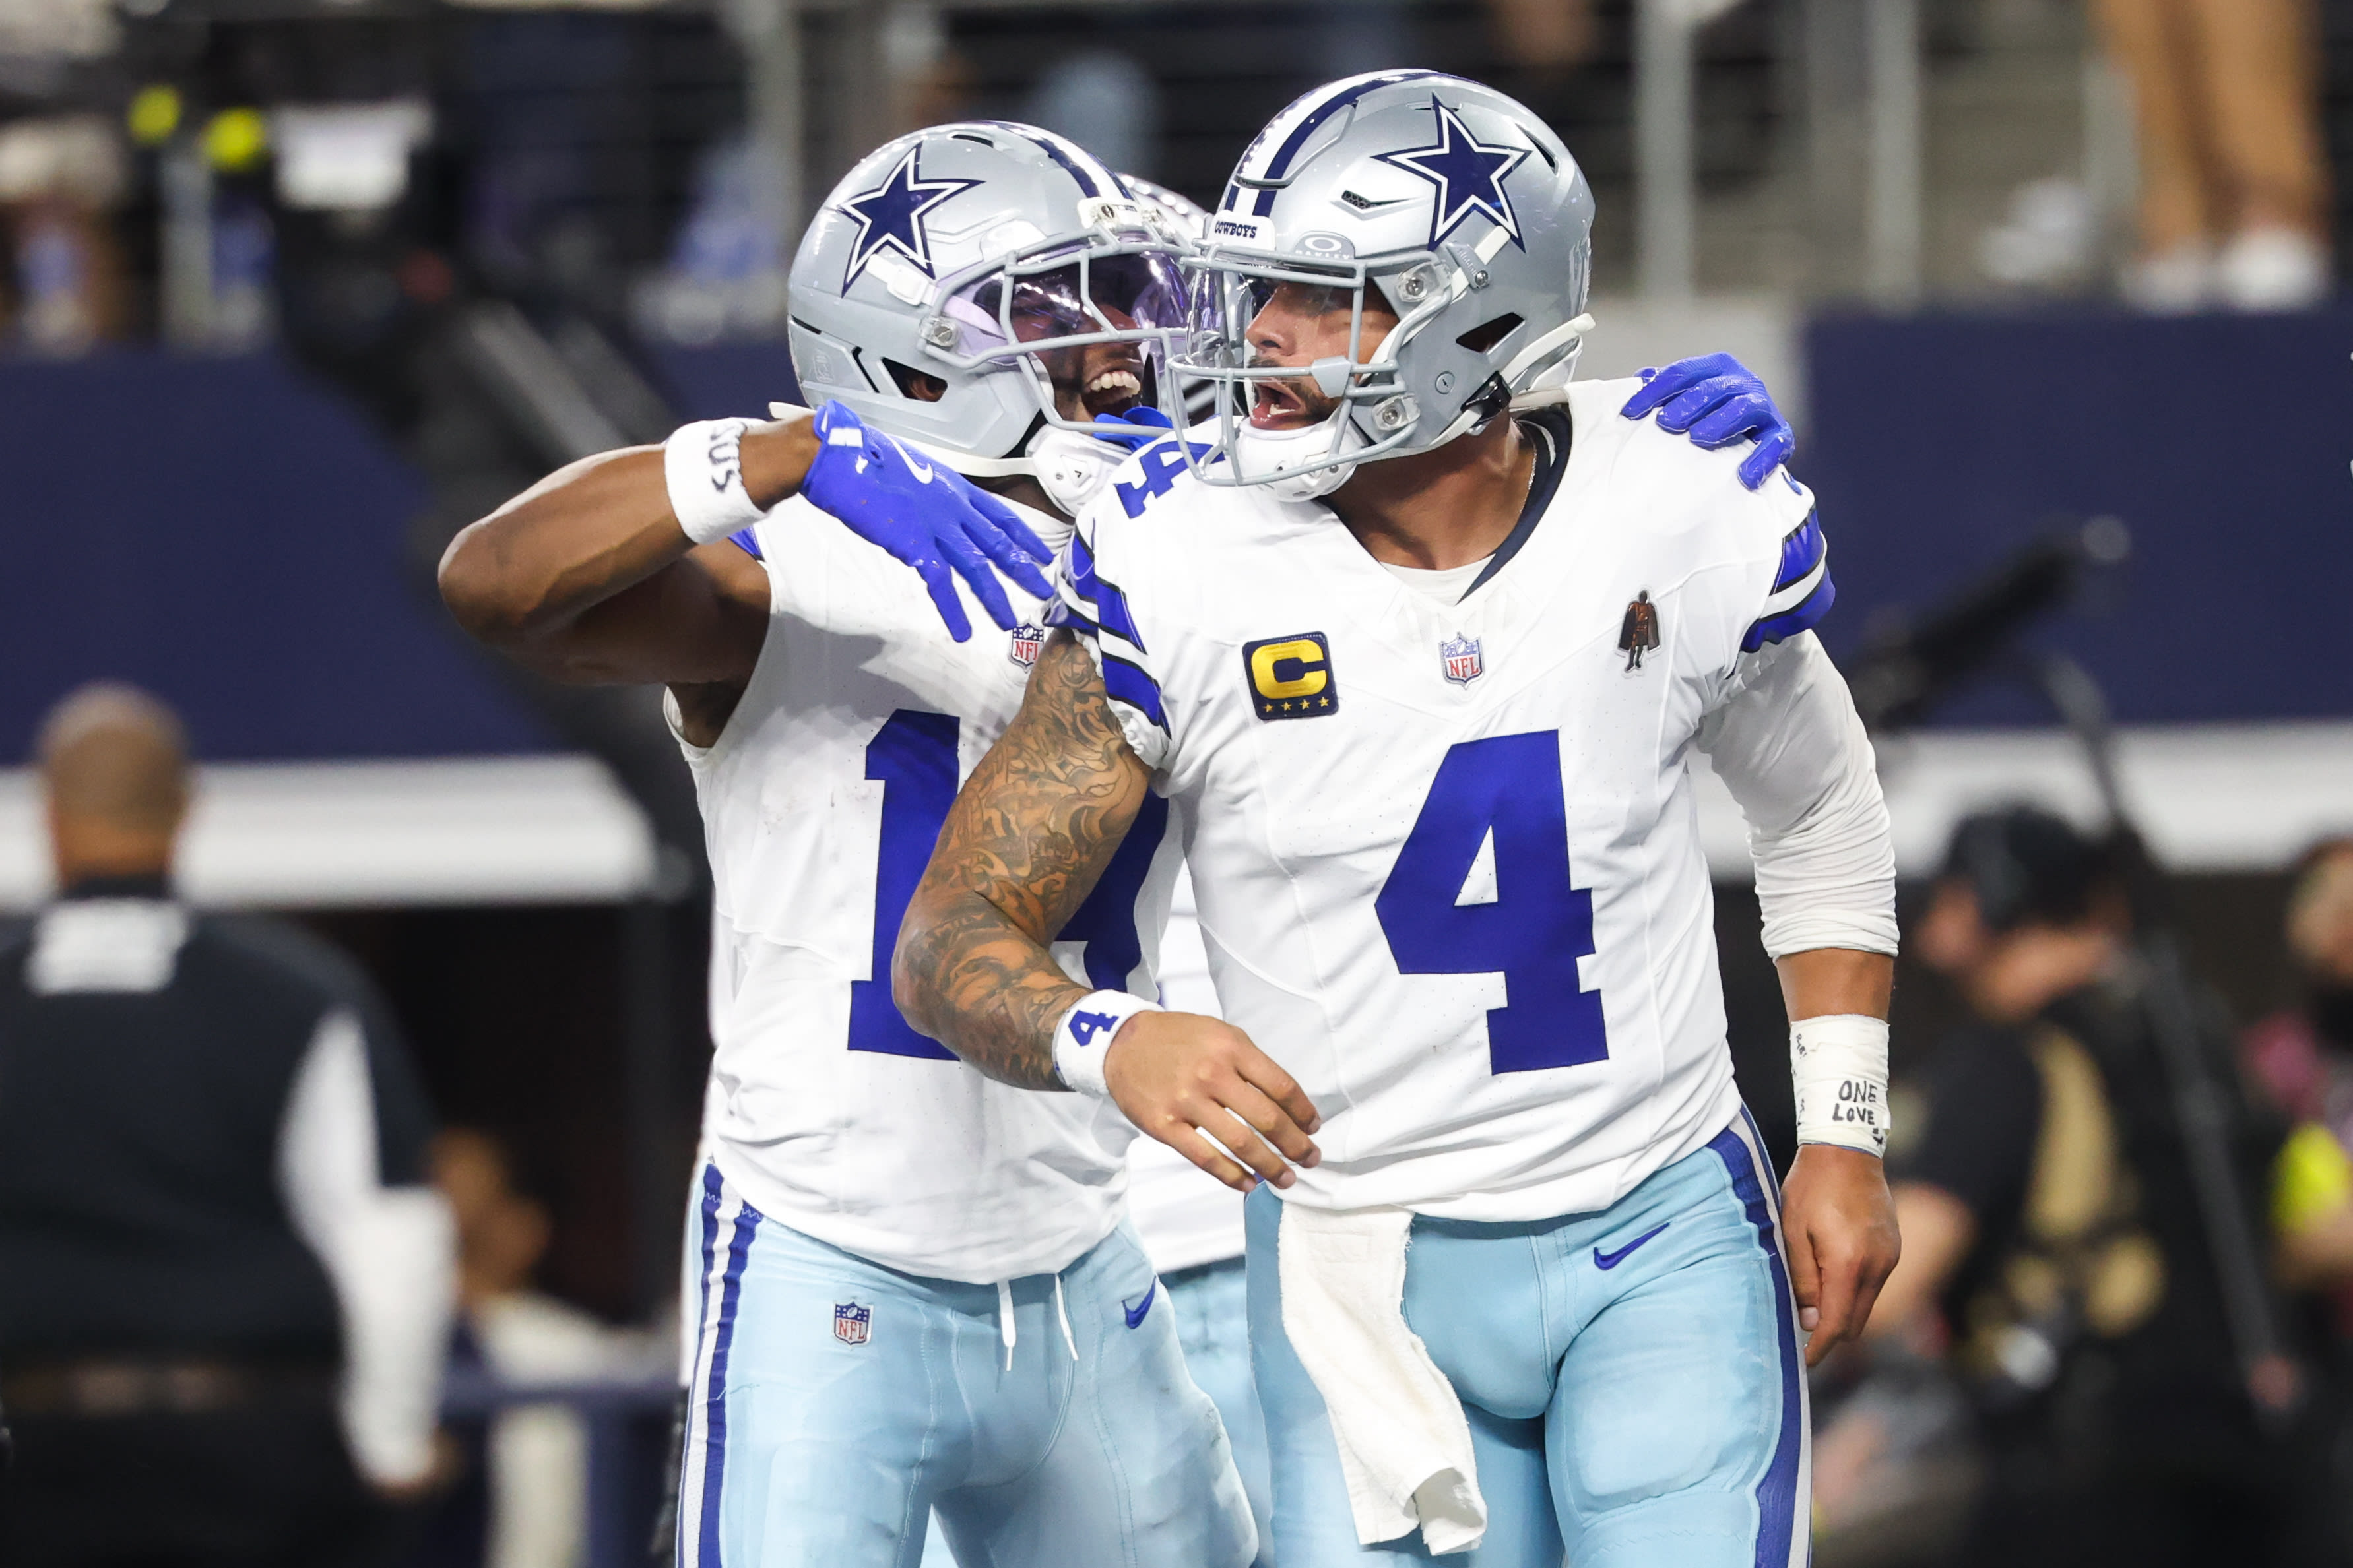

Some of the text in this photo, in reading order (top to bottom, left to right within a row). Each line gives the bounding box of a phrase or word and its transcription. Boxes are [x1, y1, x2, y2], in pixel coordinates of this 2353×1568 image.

[1214, 220, 1257, 239] COWBOYS
[1113, 440, 1226, 520] 4
[1251, 639, 1328, 699] C
[1448, 657, 1480, 679] NFL
[1374, 728, 1609, 1076] 4
[1068, 1009, 1120, 1048] 4
[1838, 1080, 1878, 1104] ONE
[1832, 1103, 1875, 1125] LOVE
[838, 1319, 865, 1341] NFL
